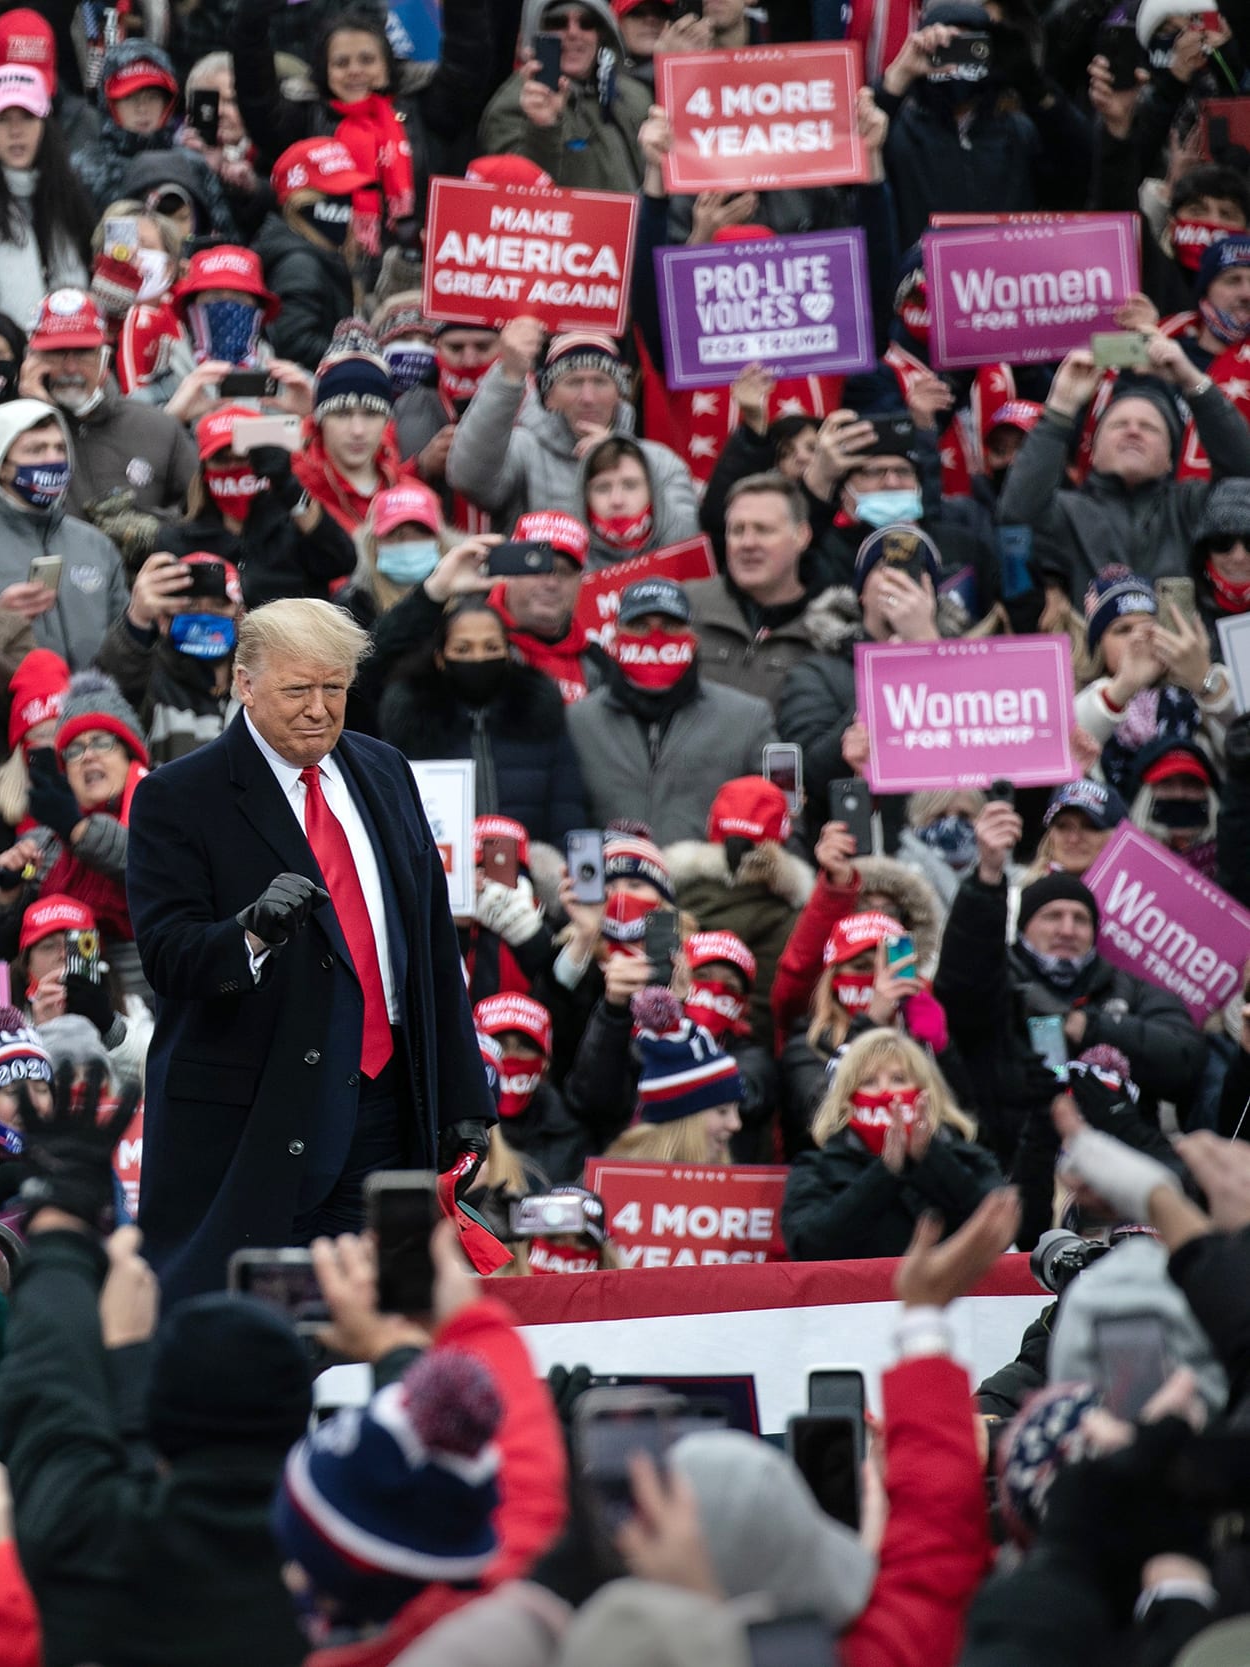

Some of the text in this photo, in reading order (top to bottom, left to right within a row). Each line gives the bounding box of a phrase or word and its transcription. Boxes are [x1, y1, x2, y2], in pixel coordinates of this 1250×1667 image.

[685, 79, 835, 119] 4 MORE
[689, 118, 834, 158] YEARS!
[314, 200, 354, 224] MA
[490, 204, 573, 237] MAKE
[435, 230, 621, 279] AMERICA
[434, 268, 619, 309] GREAT AGAIN
[693, 254, 833, 303] PRO-LIFE
[950, 266, 1113, 314] Women
[695, 294, 799, 334] VOICES
[971, 303, 1099, 330] FOR TRUMP
[882, 683, 1048, 730] Women
[904, 725, 1035, 751] FOR TRUMP
[1104, 869, 1239, 1001] Women
[1101, 919, 1206, 1006] FOR TRUMP
[838, 984, 874, 1006] MA
[612, 1201, 775, 1240] 4 MORE
